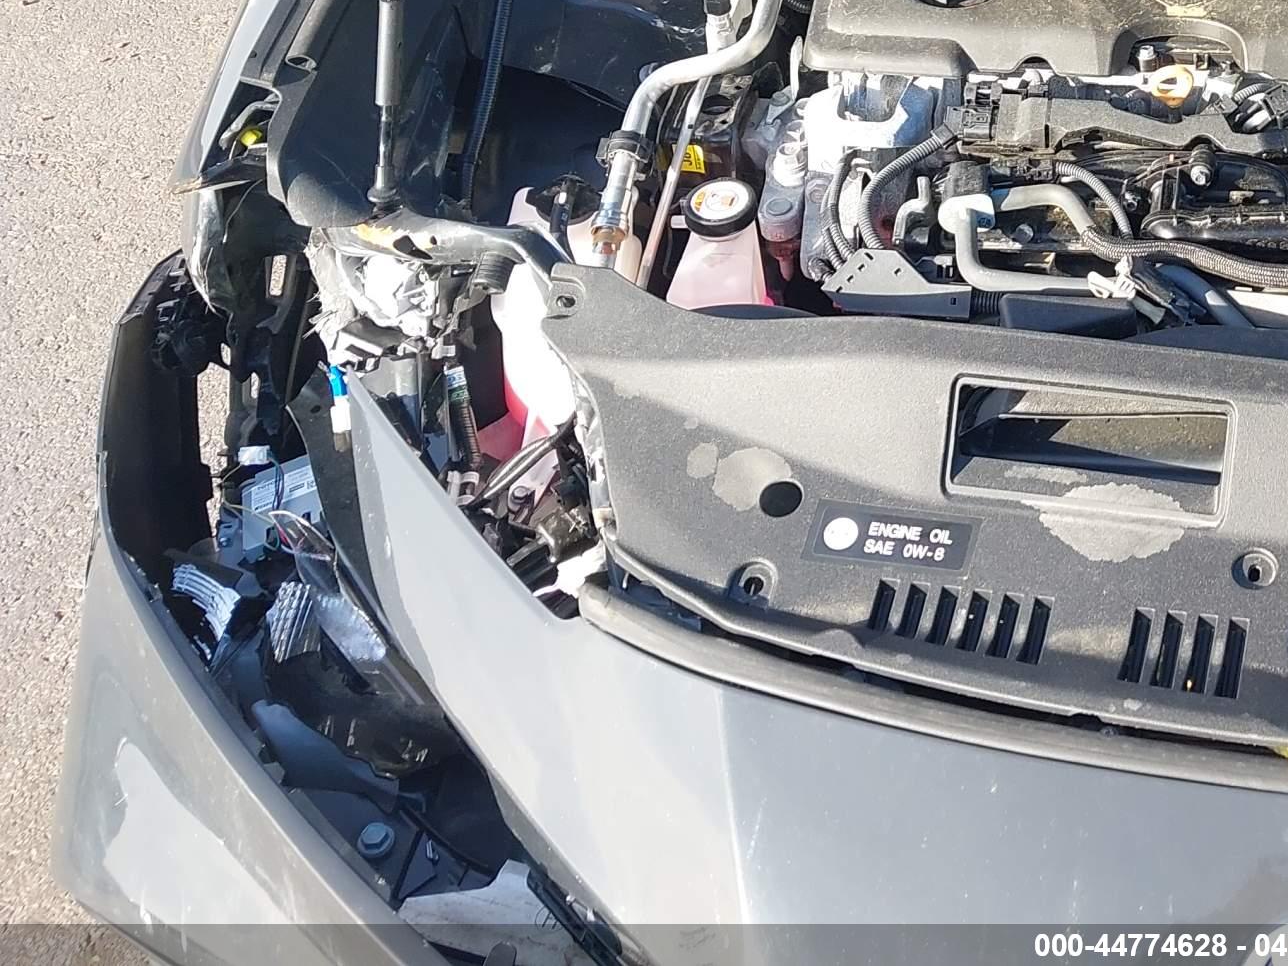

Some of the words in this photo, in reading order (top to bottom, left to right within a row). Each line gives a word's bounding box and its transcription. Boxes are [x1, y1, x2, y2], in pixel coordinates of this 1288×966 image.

[868, 521, 922, 541] ENGINE
[929, 528, 953, 545] OIL
[863, 539, 895, 555] SAE
[903, 543, 945, 562] 0W-8
